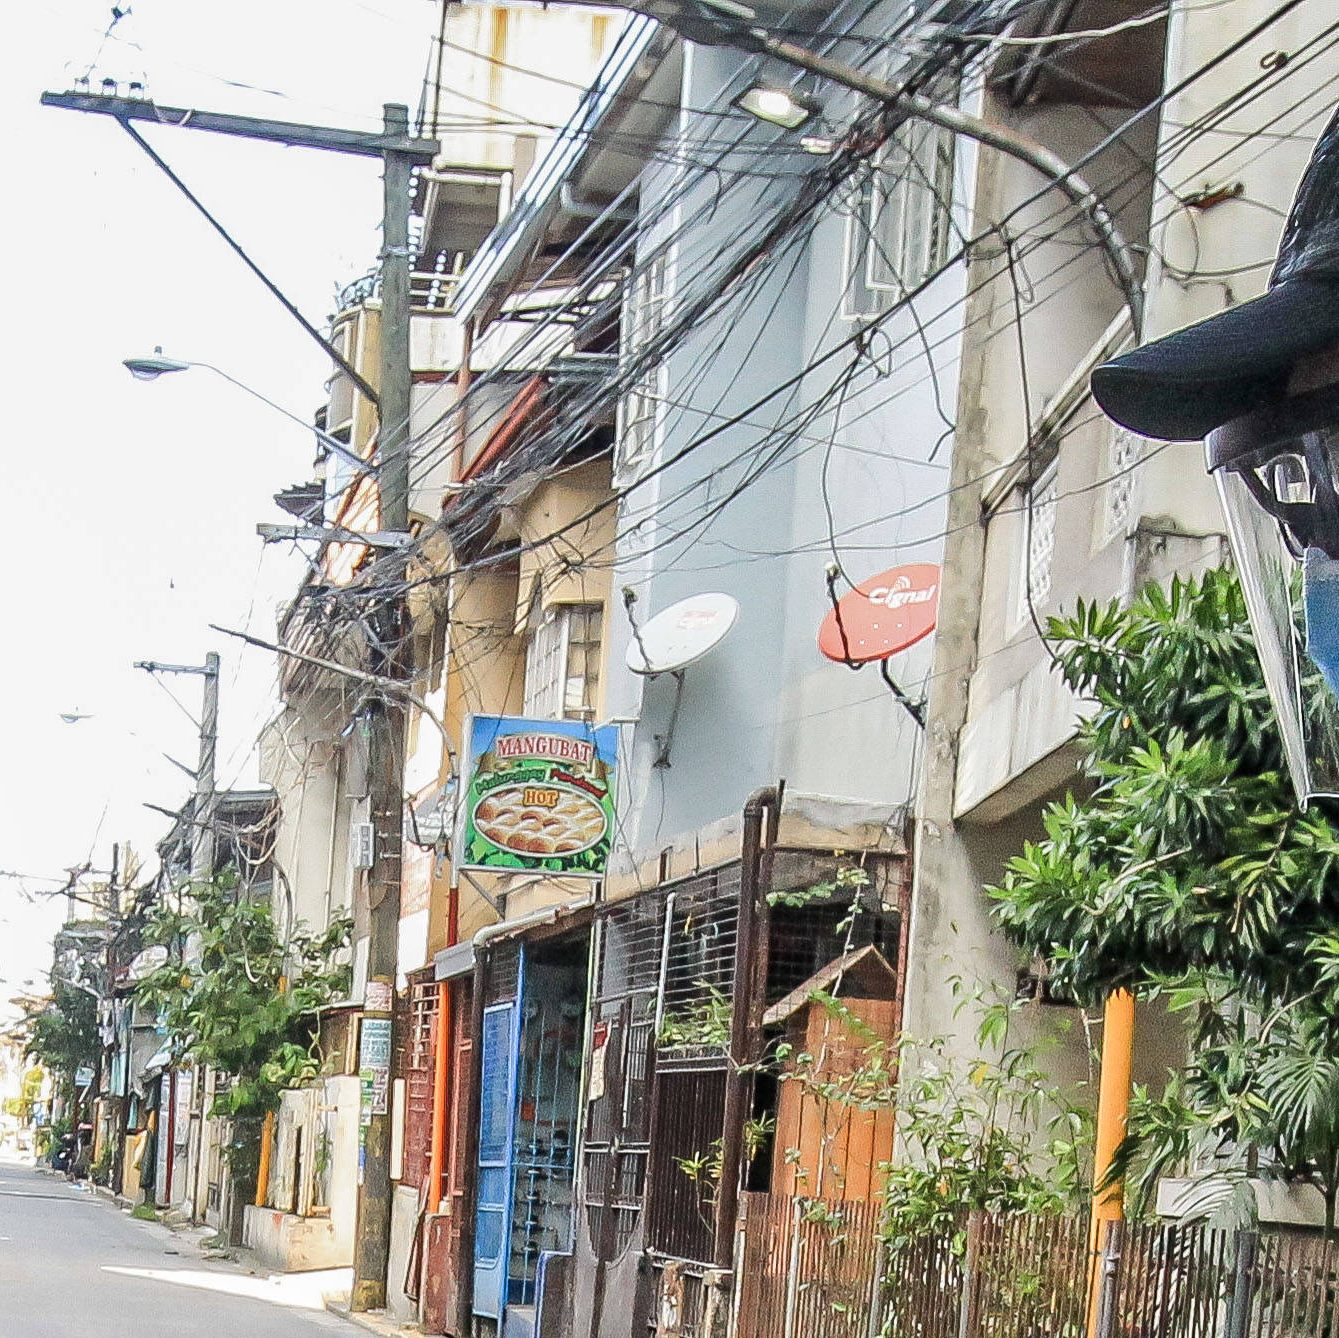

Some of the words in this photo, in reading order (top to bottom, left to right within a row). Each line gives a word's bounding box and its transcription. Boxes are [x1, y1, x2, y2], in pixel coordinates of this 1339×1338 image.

[870, 583, 938, 609] Cignal
[496, 735, 592, 762] MANGUBAT
[525, 789, 559, 806] HOT
